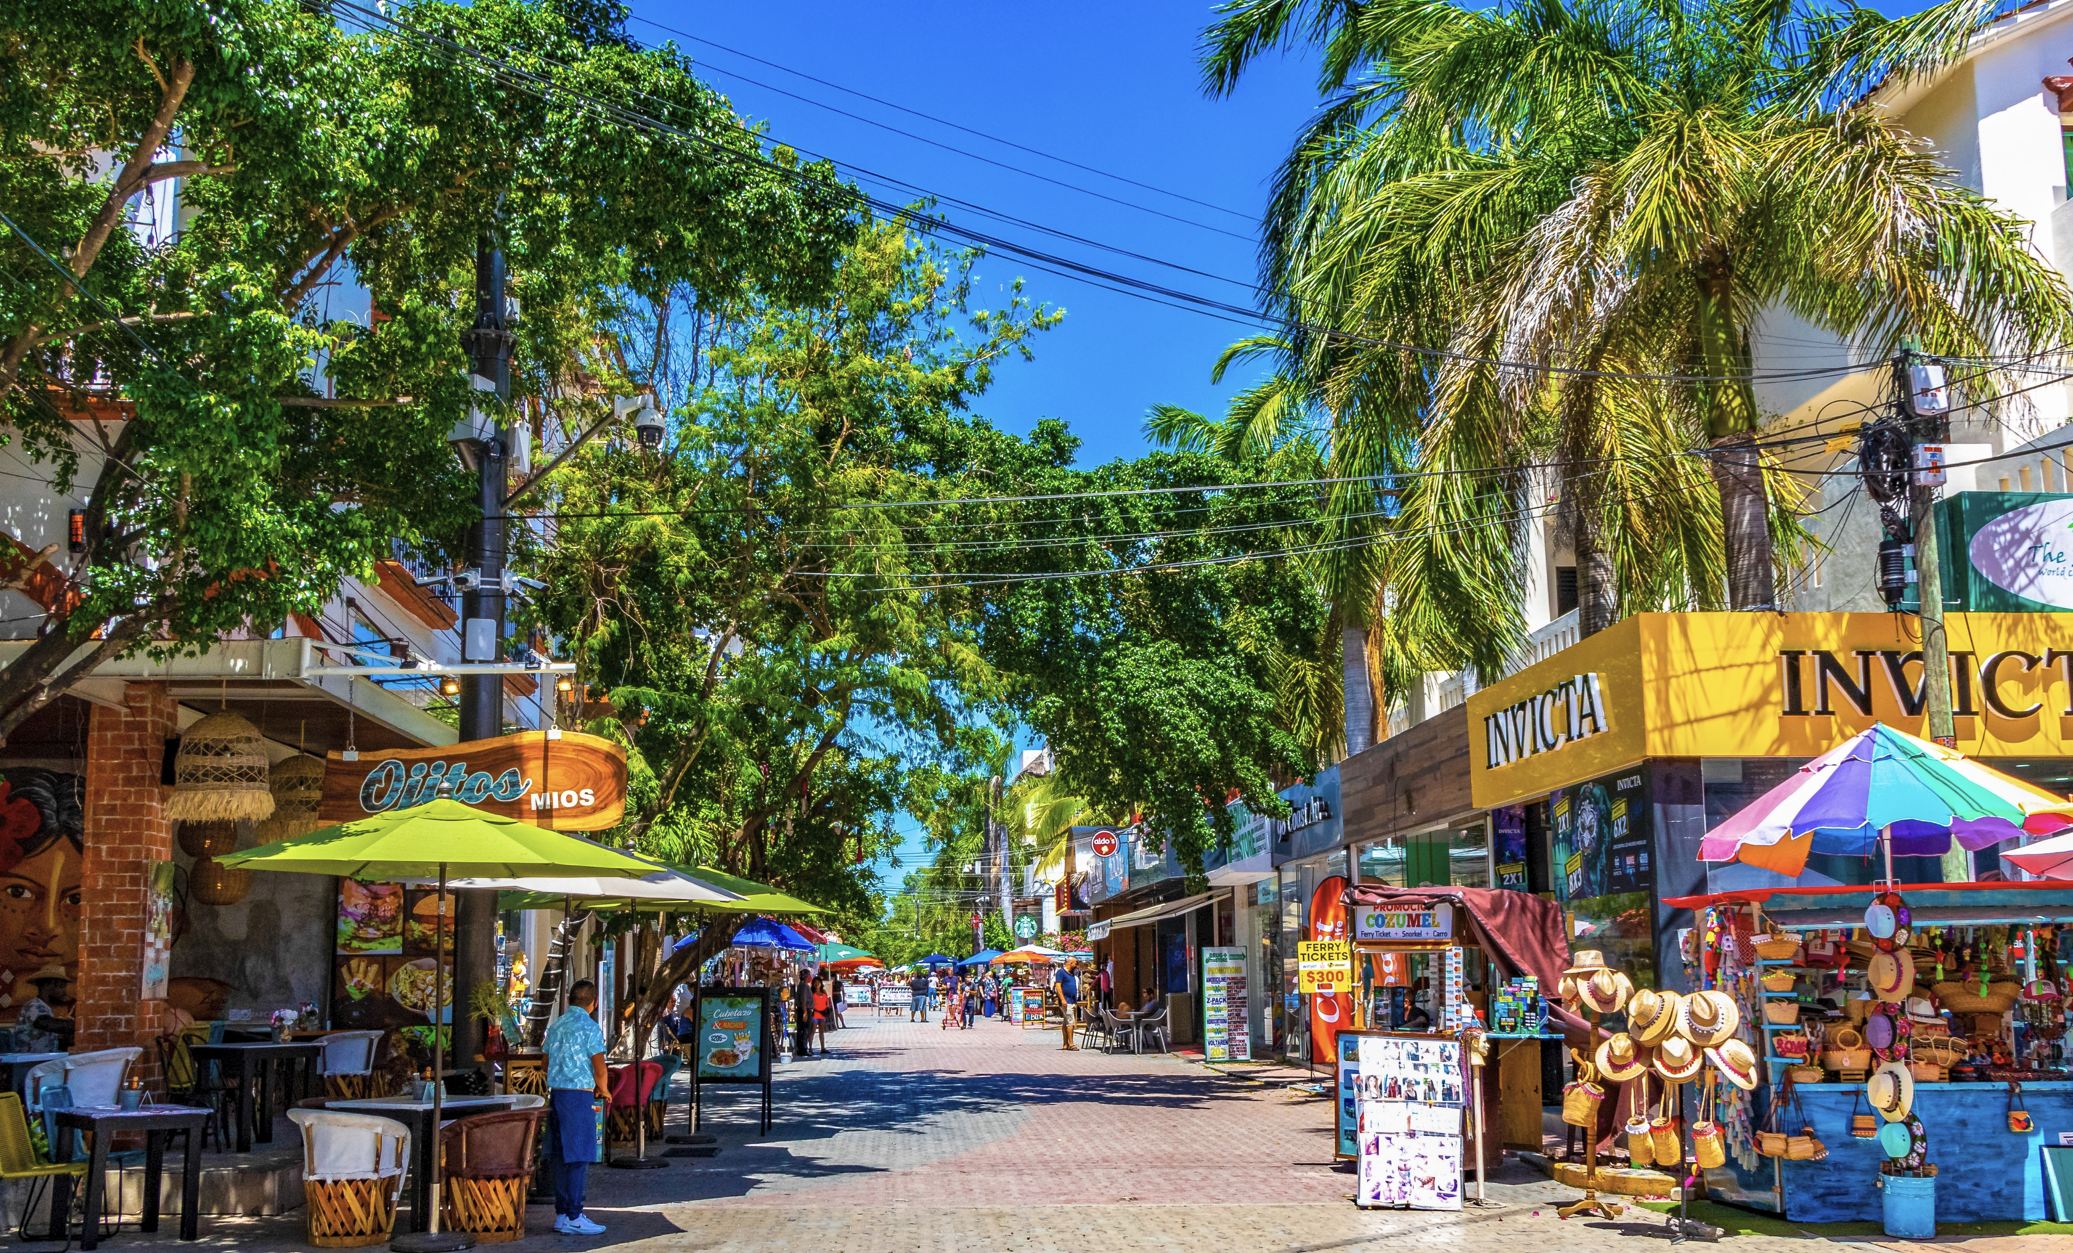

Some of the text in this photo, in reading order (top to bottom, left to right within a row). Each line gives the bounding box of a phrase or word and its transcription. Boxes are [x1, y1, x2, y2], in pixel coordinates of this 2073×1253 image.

[2029, 542, 2066, 563] The
[2039, 567, 2065, 577] world
[1484, 672, 1608, 770] INVICTA
[1617, 775, 1642, 790] INVICTA
[531, 788, 595, 811] MIOS
[1558, 811, 1569, 833] 2X1
[1613, 815, 1627, 838] 6X2
[1503, 873, 1523, 885] 2X1
[1569, 867, 1582, 893] 8X3
[1365, 912, 1440, 928] COZUMEL
[1361, 931, 1374, 939] Ferry
[1306, 943, 1341, 951] FERRY
[1300, 952, 1348, 961] TICKETS
[1306, 971, 1344, 984] $300
